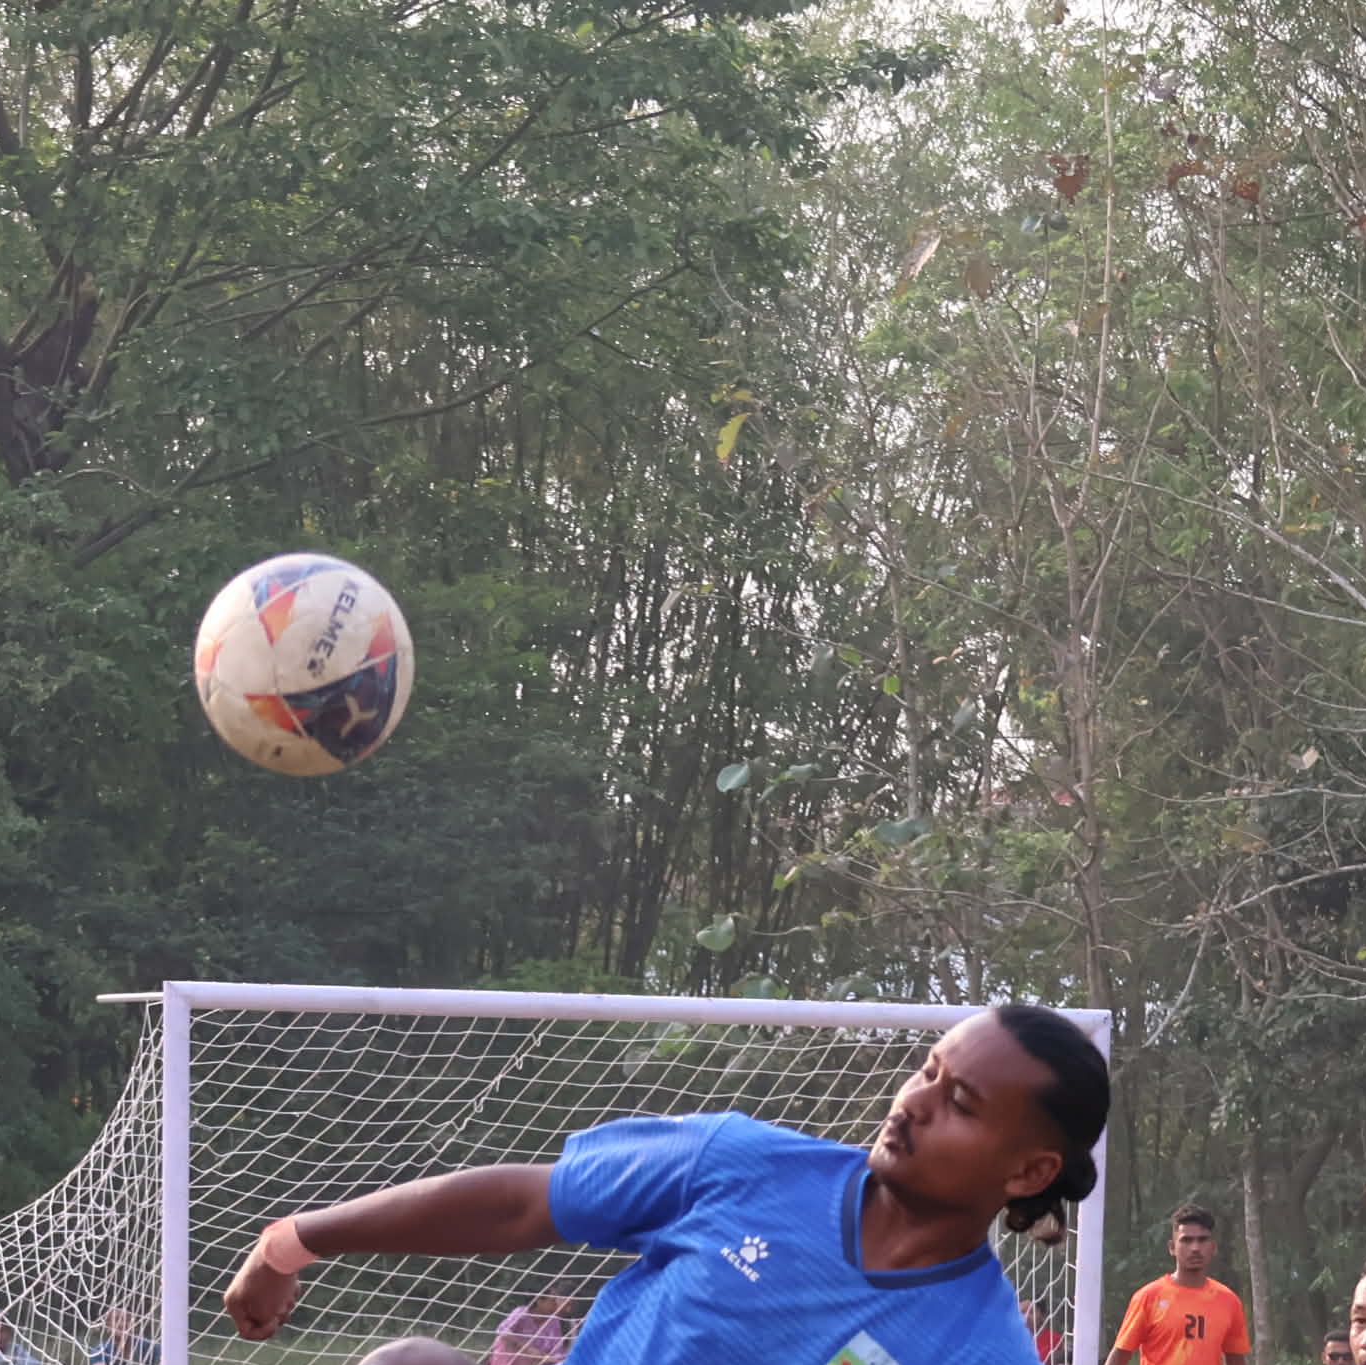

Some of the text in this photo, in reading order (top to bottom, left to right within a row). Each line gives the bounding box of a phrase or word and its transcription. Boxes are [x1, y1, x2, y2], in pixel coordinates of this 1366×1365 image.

[315, 577, 360, 659] KELME
[720, 1247, 760, 1282] KELME
[1185, 1313, 1205, 1339] 21
